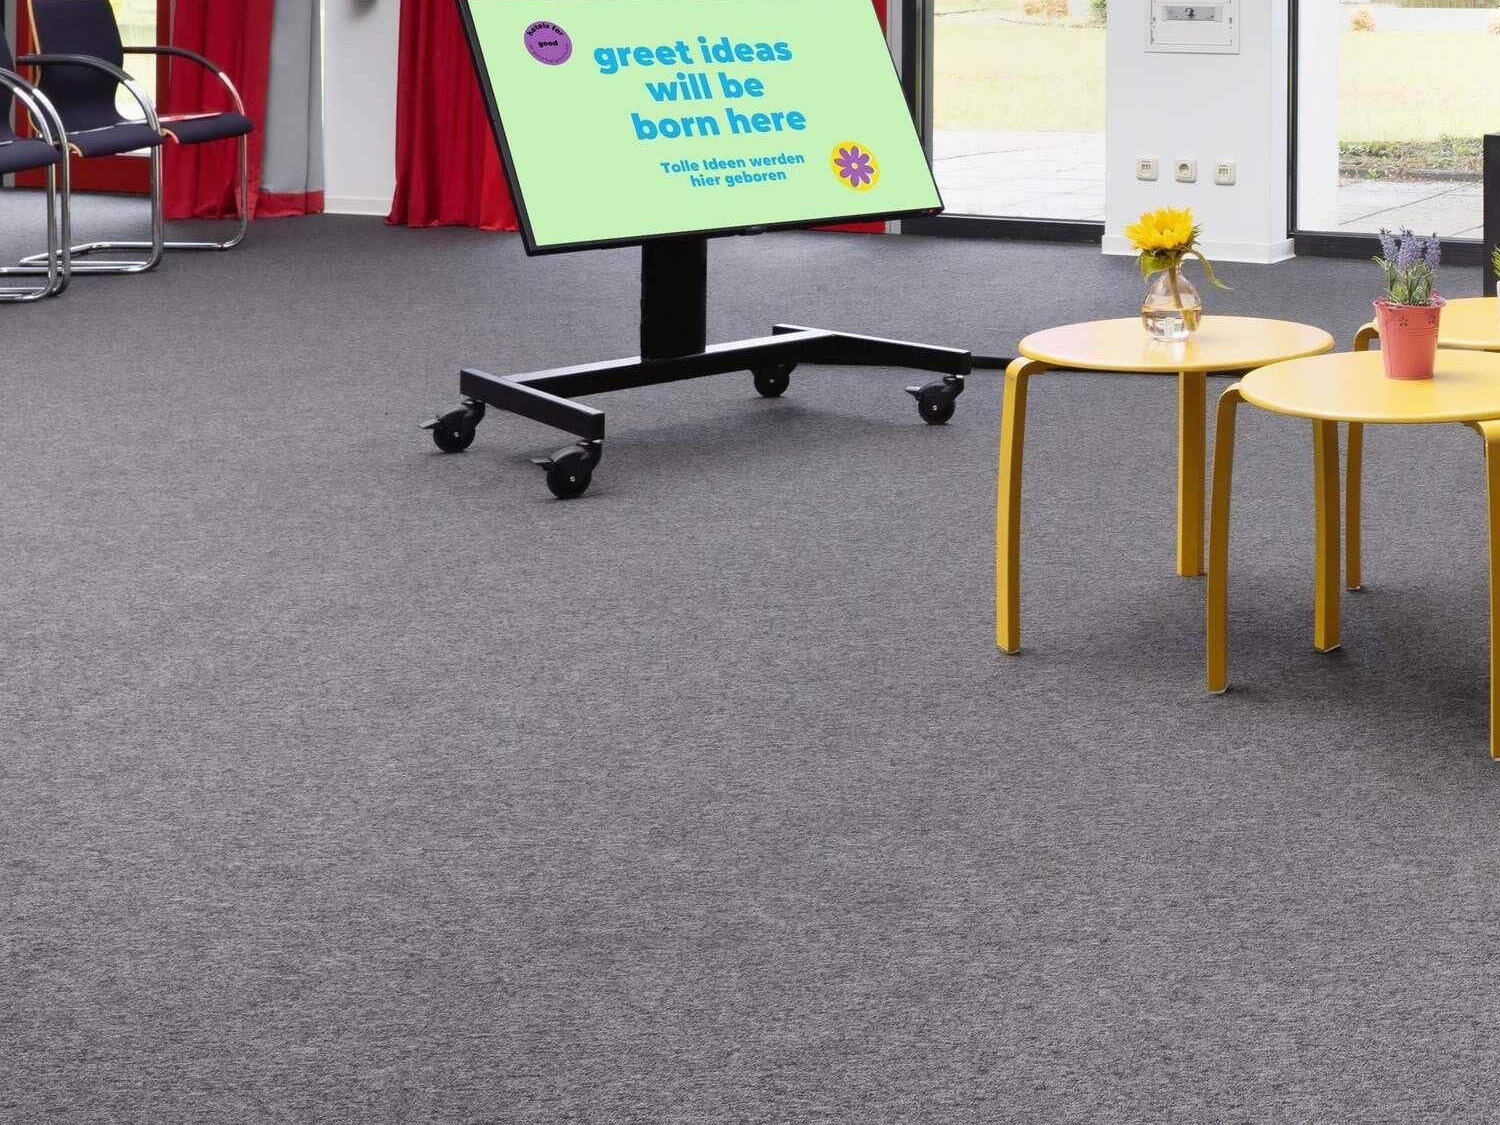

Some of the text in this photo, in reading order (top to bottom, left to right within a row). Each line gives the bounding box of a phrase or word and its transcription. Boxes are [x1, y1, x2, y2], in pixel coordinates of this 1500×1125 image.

[538, 40, 558, 48] good
[593, 39, 693, 74] greet
[698, 35, 793, 64] ideas
[645, 71, 764, 102] will be
[631, 106, 807, 140] born here
[660, 153, 805, 174] Tolle Ideen werden
[690, 169, 787, 188] hier geboren
